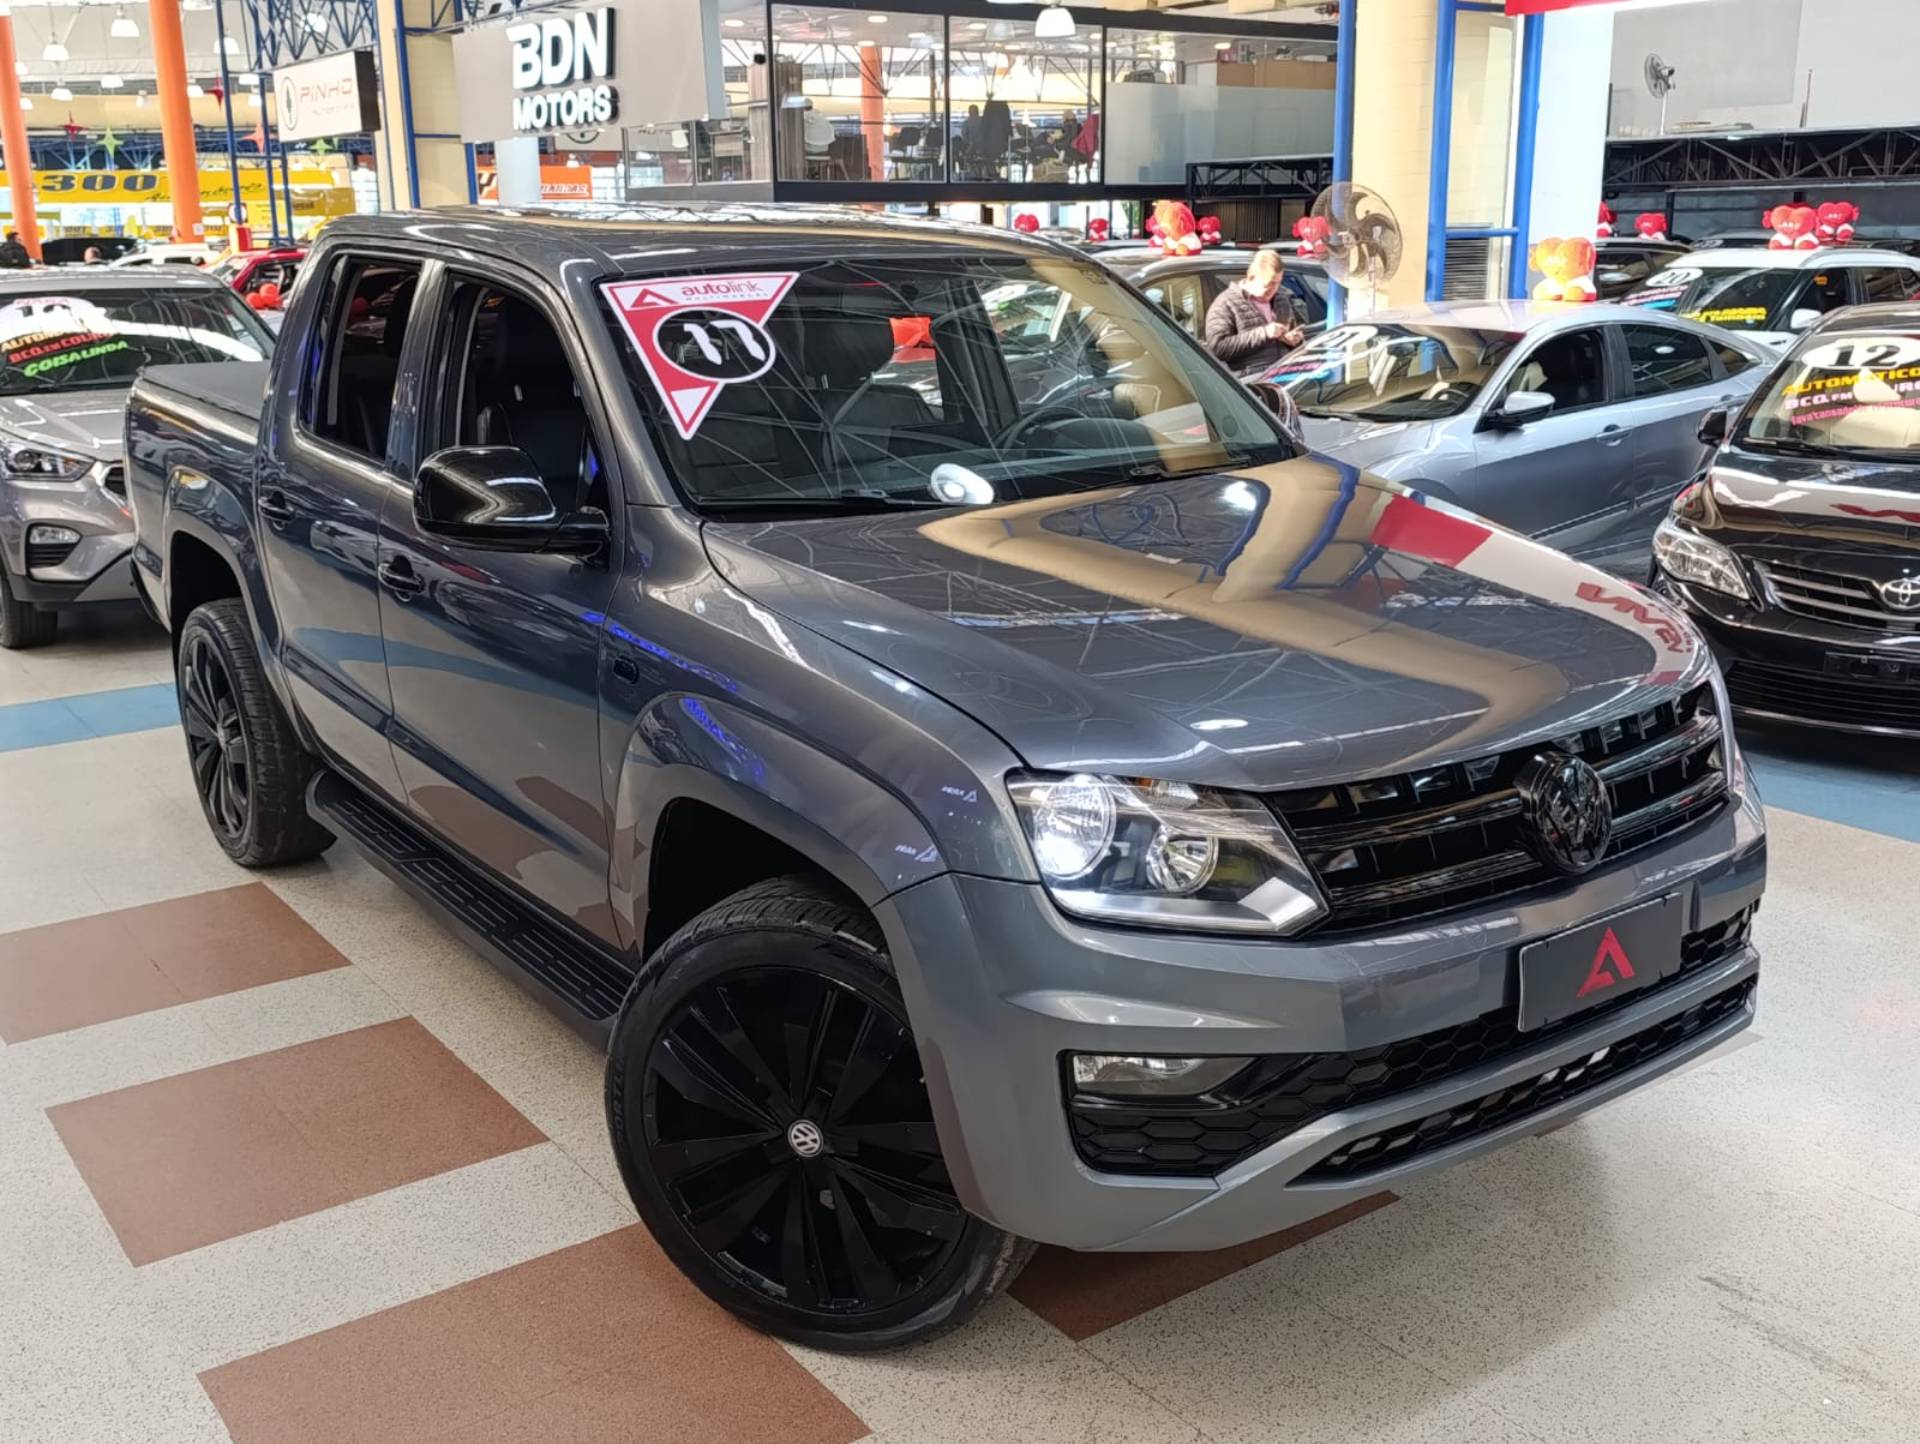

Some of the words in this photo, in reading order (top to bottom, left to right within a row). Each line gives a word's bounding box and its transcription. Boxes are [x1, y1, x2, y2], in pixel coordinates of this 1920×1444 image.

[506, 7, 614, 90] BDN
[299, 77, 353, 102] PINHO
[512, 85, 615, 130] MOTORS
[41, 173, 159, 191] 300
[681, 280, 764, 296] autolink
[1827, 344, 1901, 368] 12
